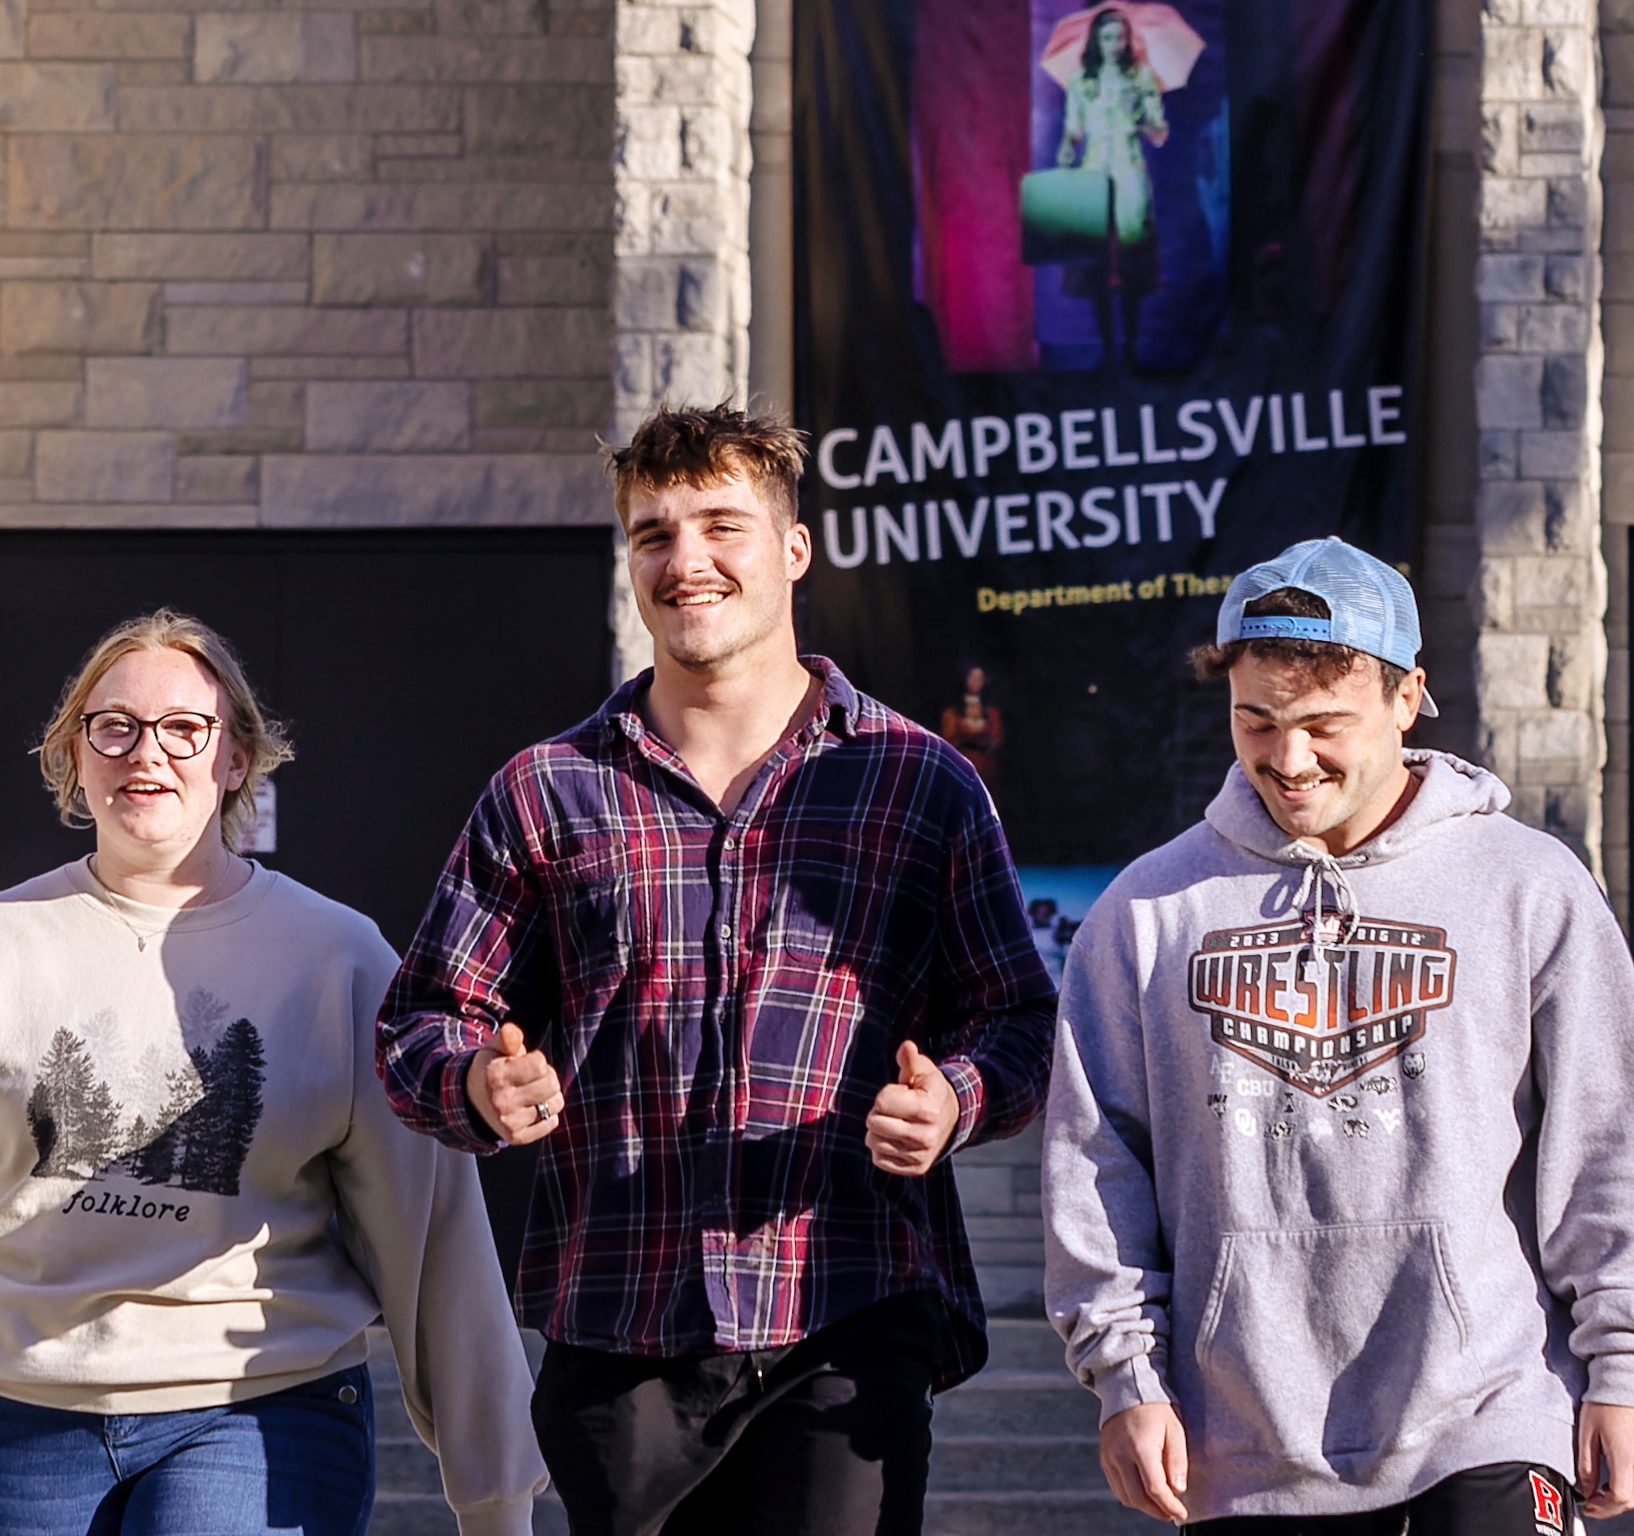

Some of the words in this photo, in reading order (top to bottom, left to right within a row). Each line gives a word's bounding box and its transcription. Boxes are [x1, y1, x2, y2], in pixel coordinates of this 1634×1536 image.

[817, 385, 1407, 490] CAMPBELLSVILLE
[822, 478, 1228, 570] UNIVERSITY
[977, 580, 1134, 616] Department
[1137, 574, 1167, 600] of
[1170, 573, 1233, 598] Thea
[1230, 932, 1279, 948] 2023
[1357, 928, 1390, 943] BIG
[1195, 949, 1448, 1030] WRESTLING
[1223, 1015, 1414, 1059] CHAMPIONSHIP
[1237, 1078, 1275, 1097] CBU
[62, 1189, 191, 1222] folklore
[1528, 1469, 1564, 1532] R
